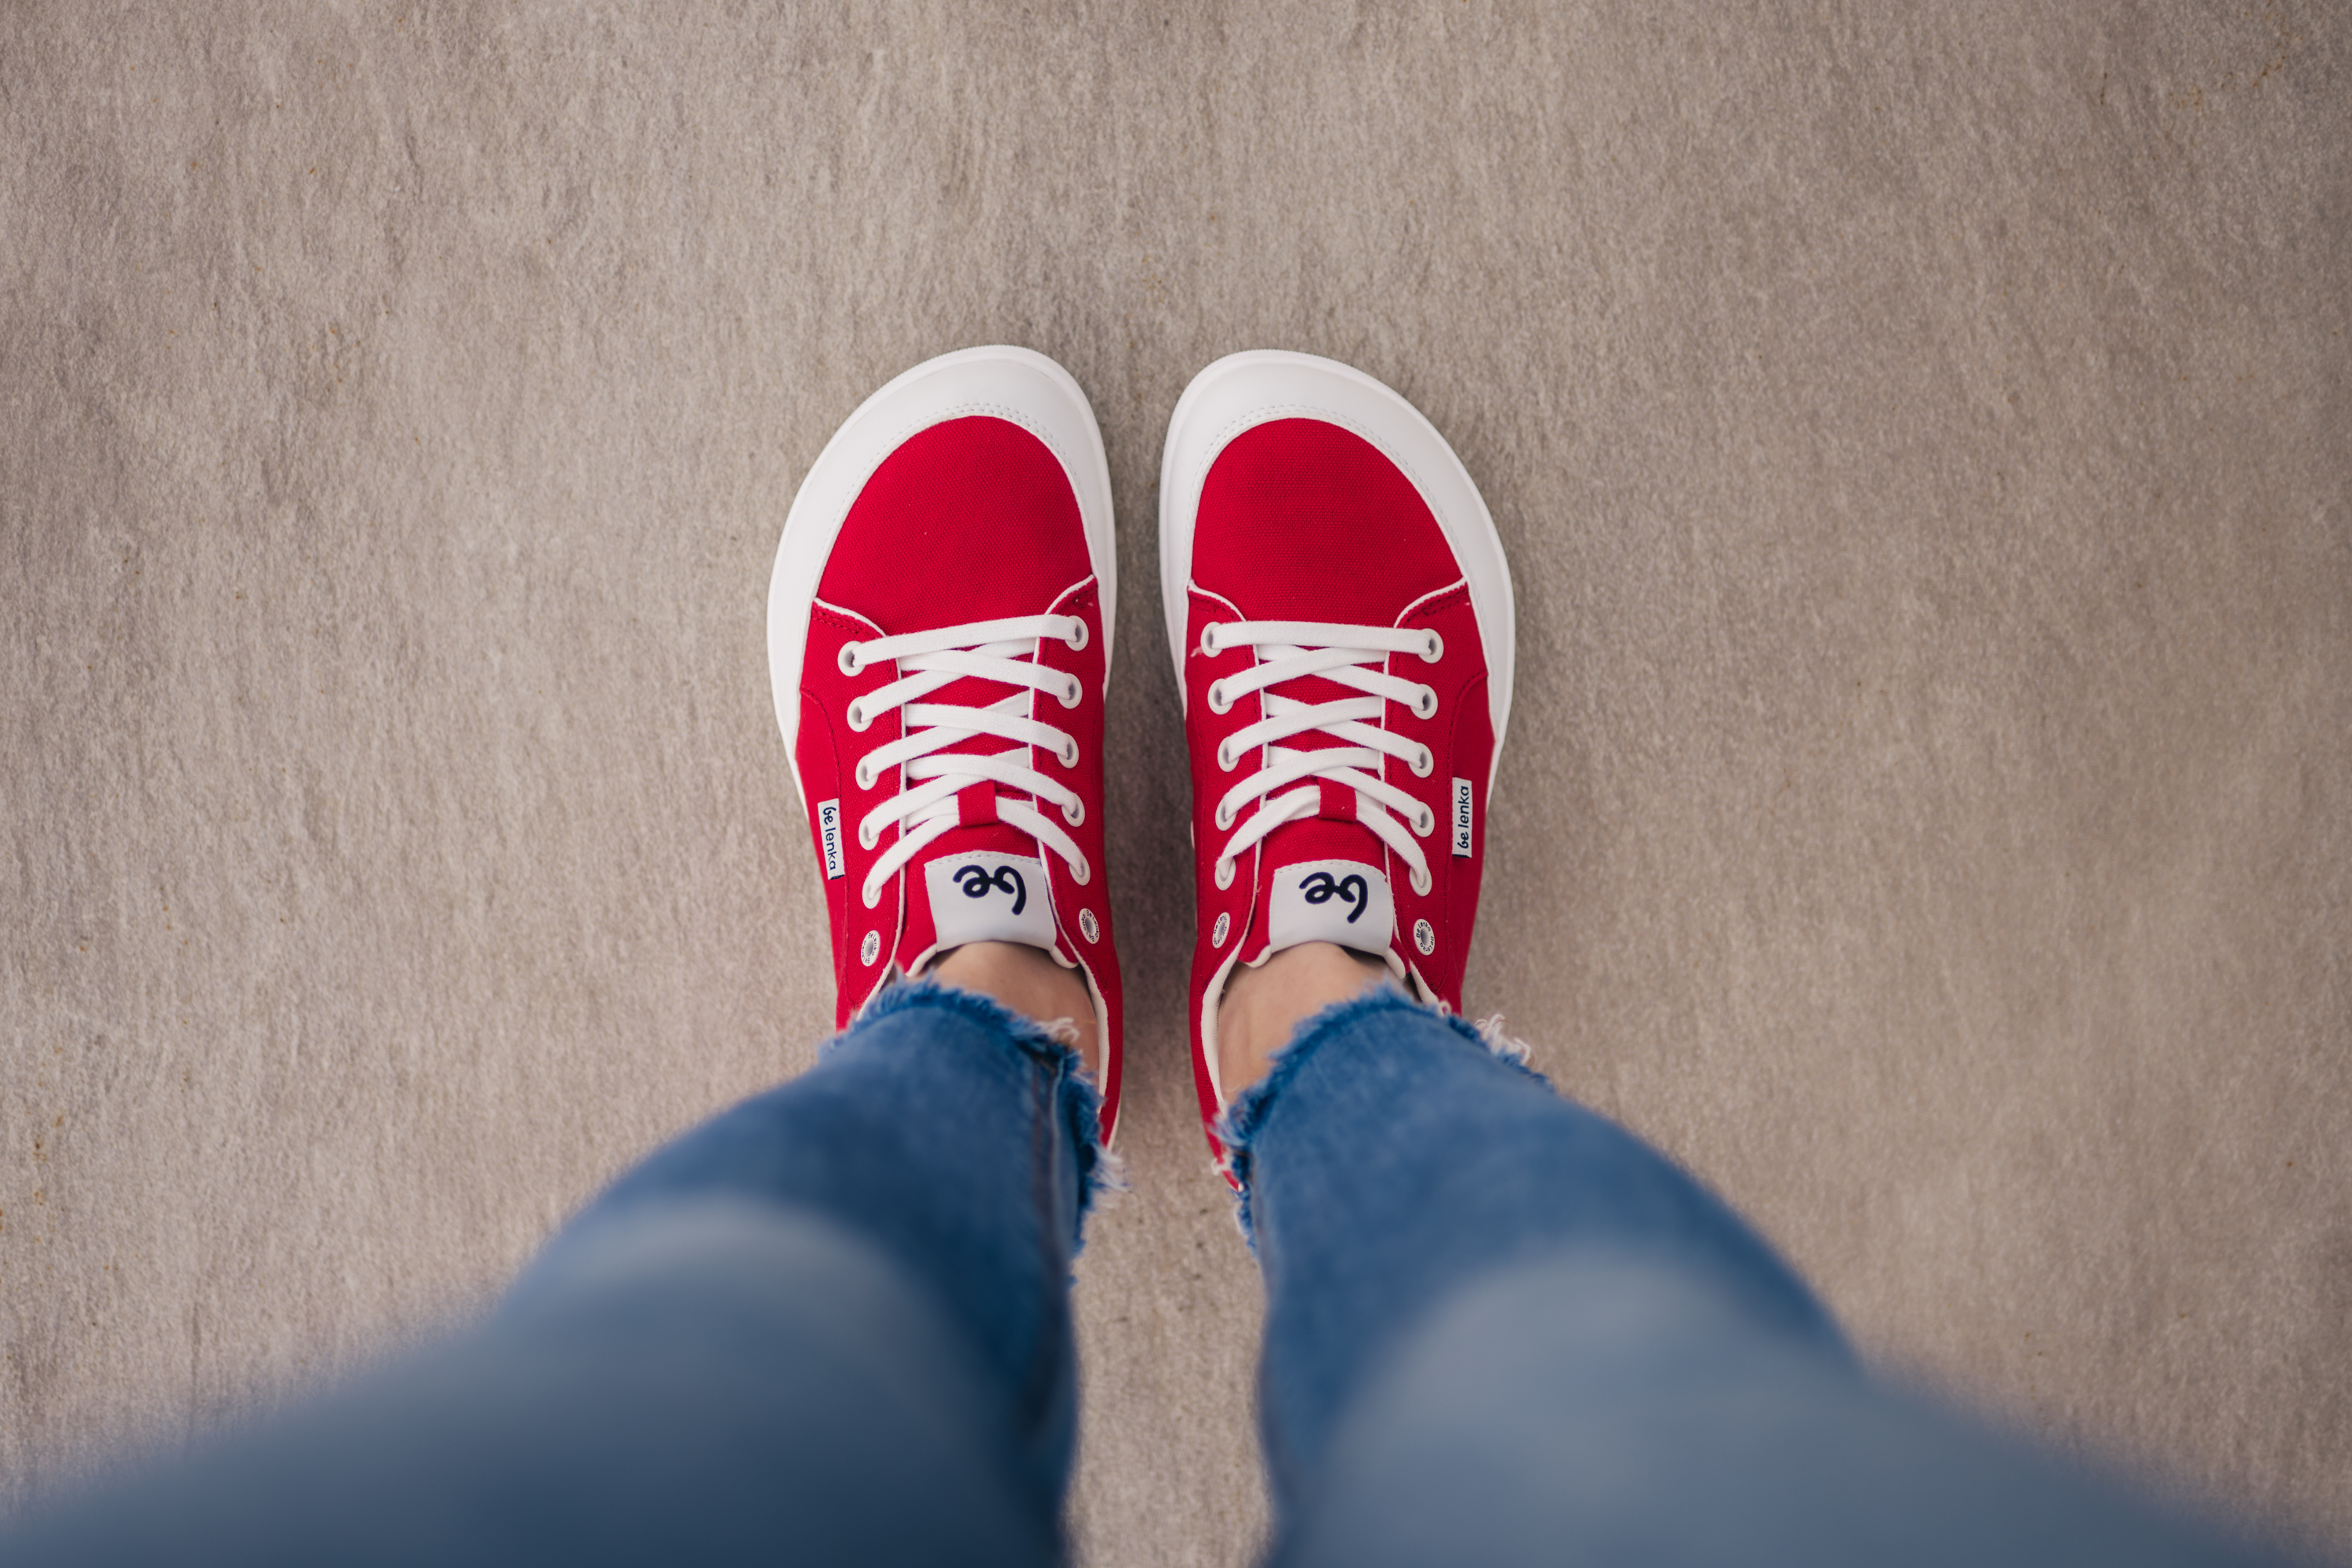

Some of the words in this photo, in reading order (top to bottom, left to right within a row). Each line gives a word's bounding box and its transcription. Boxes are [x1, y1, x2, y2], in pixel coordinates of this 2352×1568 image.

[822, 807, 837, 825] be
[1457, 786, 1469, 828] lenka
[825, 826, 837, 870] lenka
[1457, 831, 1469, 849] be
[1417, 922, 1431, 931] Lenka
